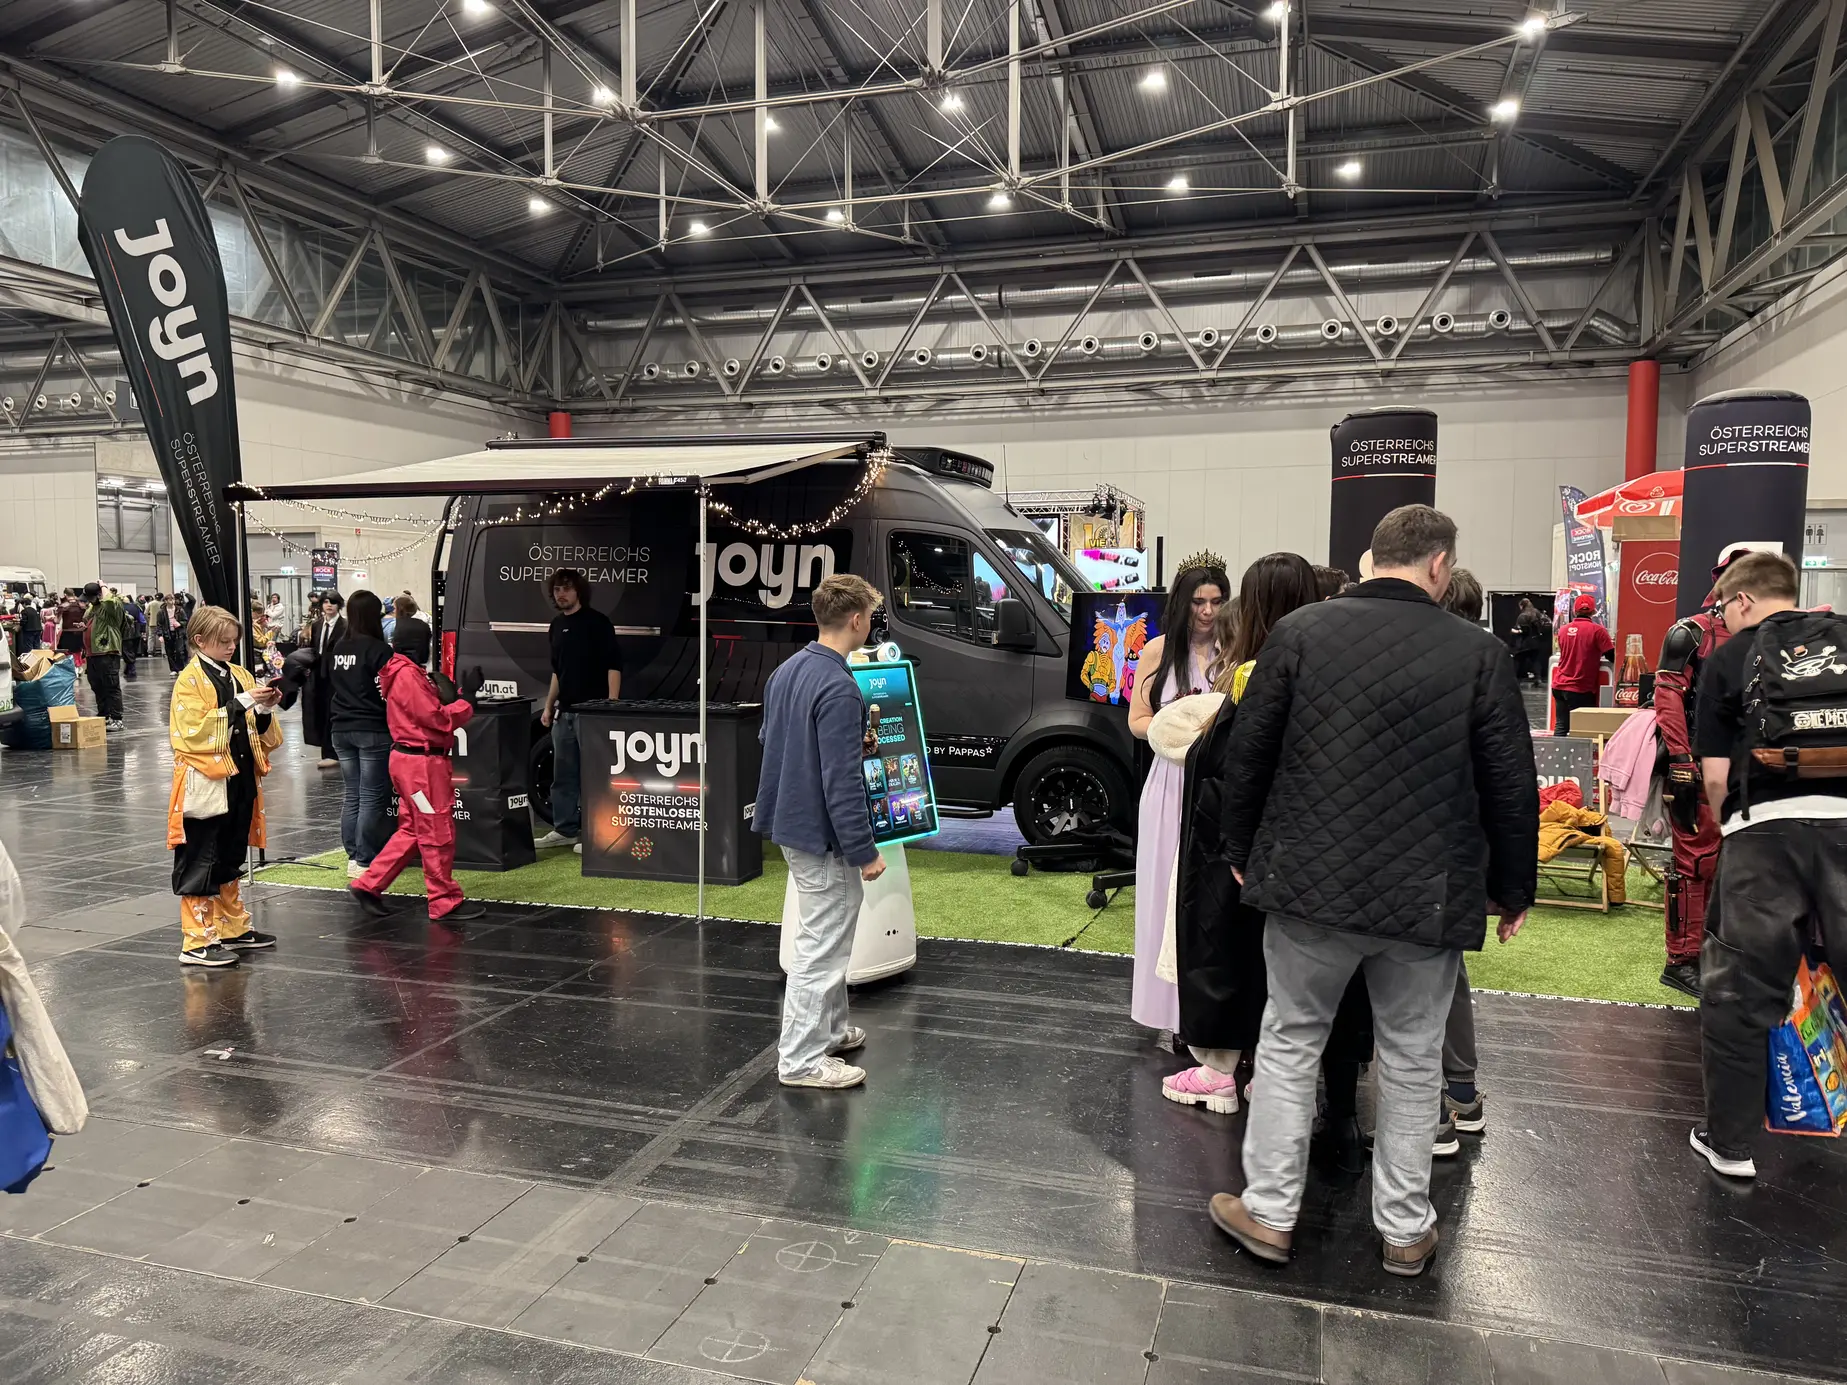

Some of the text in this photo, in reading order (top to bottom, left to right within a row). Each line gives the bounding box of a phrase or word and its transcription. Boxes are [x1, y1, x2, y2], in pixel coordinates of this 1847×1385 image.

[114, 218, 219, 406] joyn
[1710, 425, 1809, 440] ÖSTERREICHS
[1350, 439, 1435, 453] ÖSTERREICHS
[1699, 440, 1810, 456] SUPERSTREAME
[1341, 453, 1437, 468] SUPERSTREAME
[170, 438, 221, 567] SUPERSTREAMER
[529, 542, 651, 562] ÖSTERREICHS
[499, 566, 649, 584] SUPERREAMER
[691, 542, 836, 609] joyn
[333, 654, 357, 670] joyn
[477, 683, 515, 695] oyn.at
[868, 677, 887, 689] joyn
[1825, 709, 1847, 728] PIE
[877, 722, 905, 736] BEING
[877, 734, 906, 745] OCESSED
[609, 730, 707, 778] joyn
[619, 791, 699, 807] ÖSTERREICHS
[618, 805, 701, 819] KOSTENLOSER
[1776, 1052, 1807, 1122] Valencia
